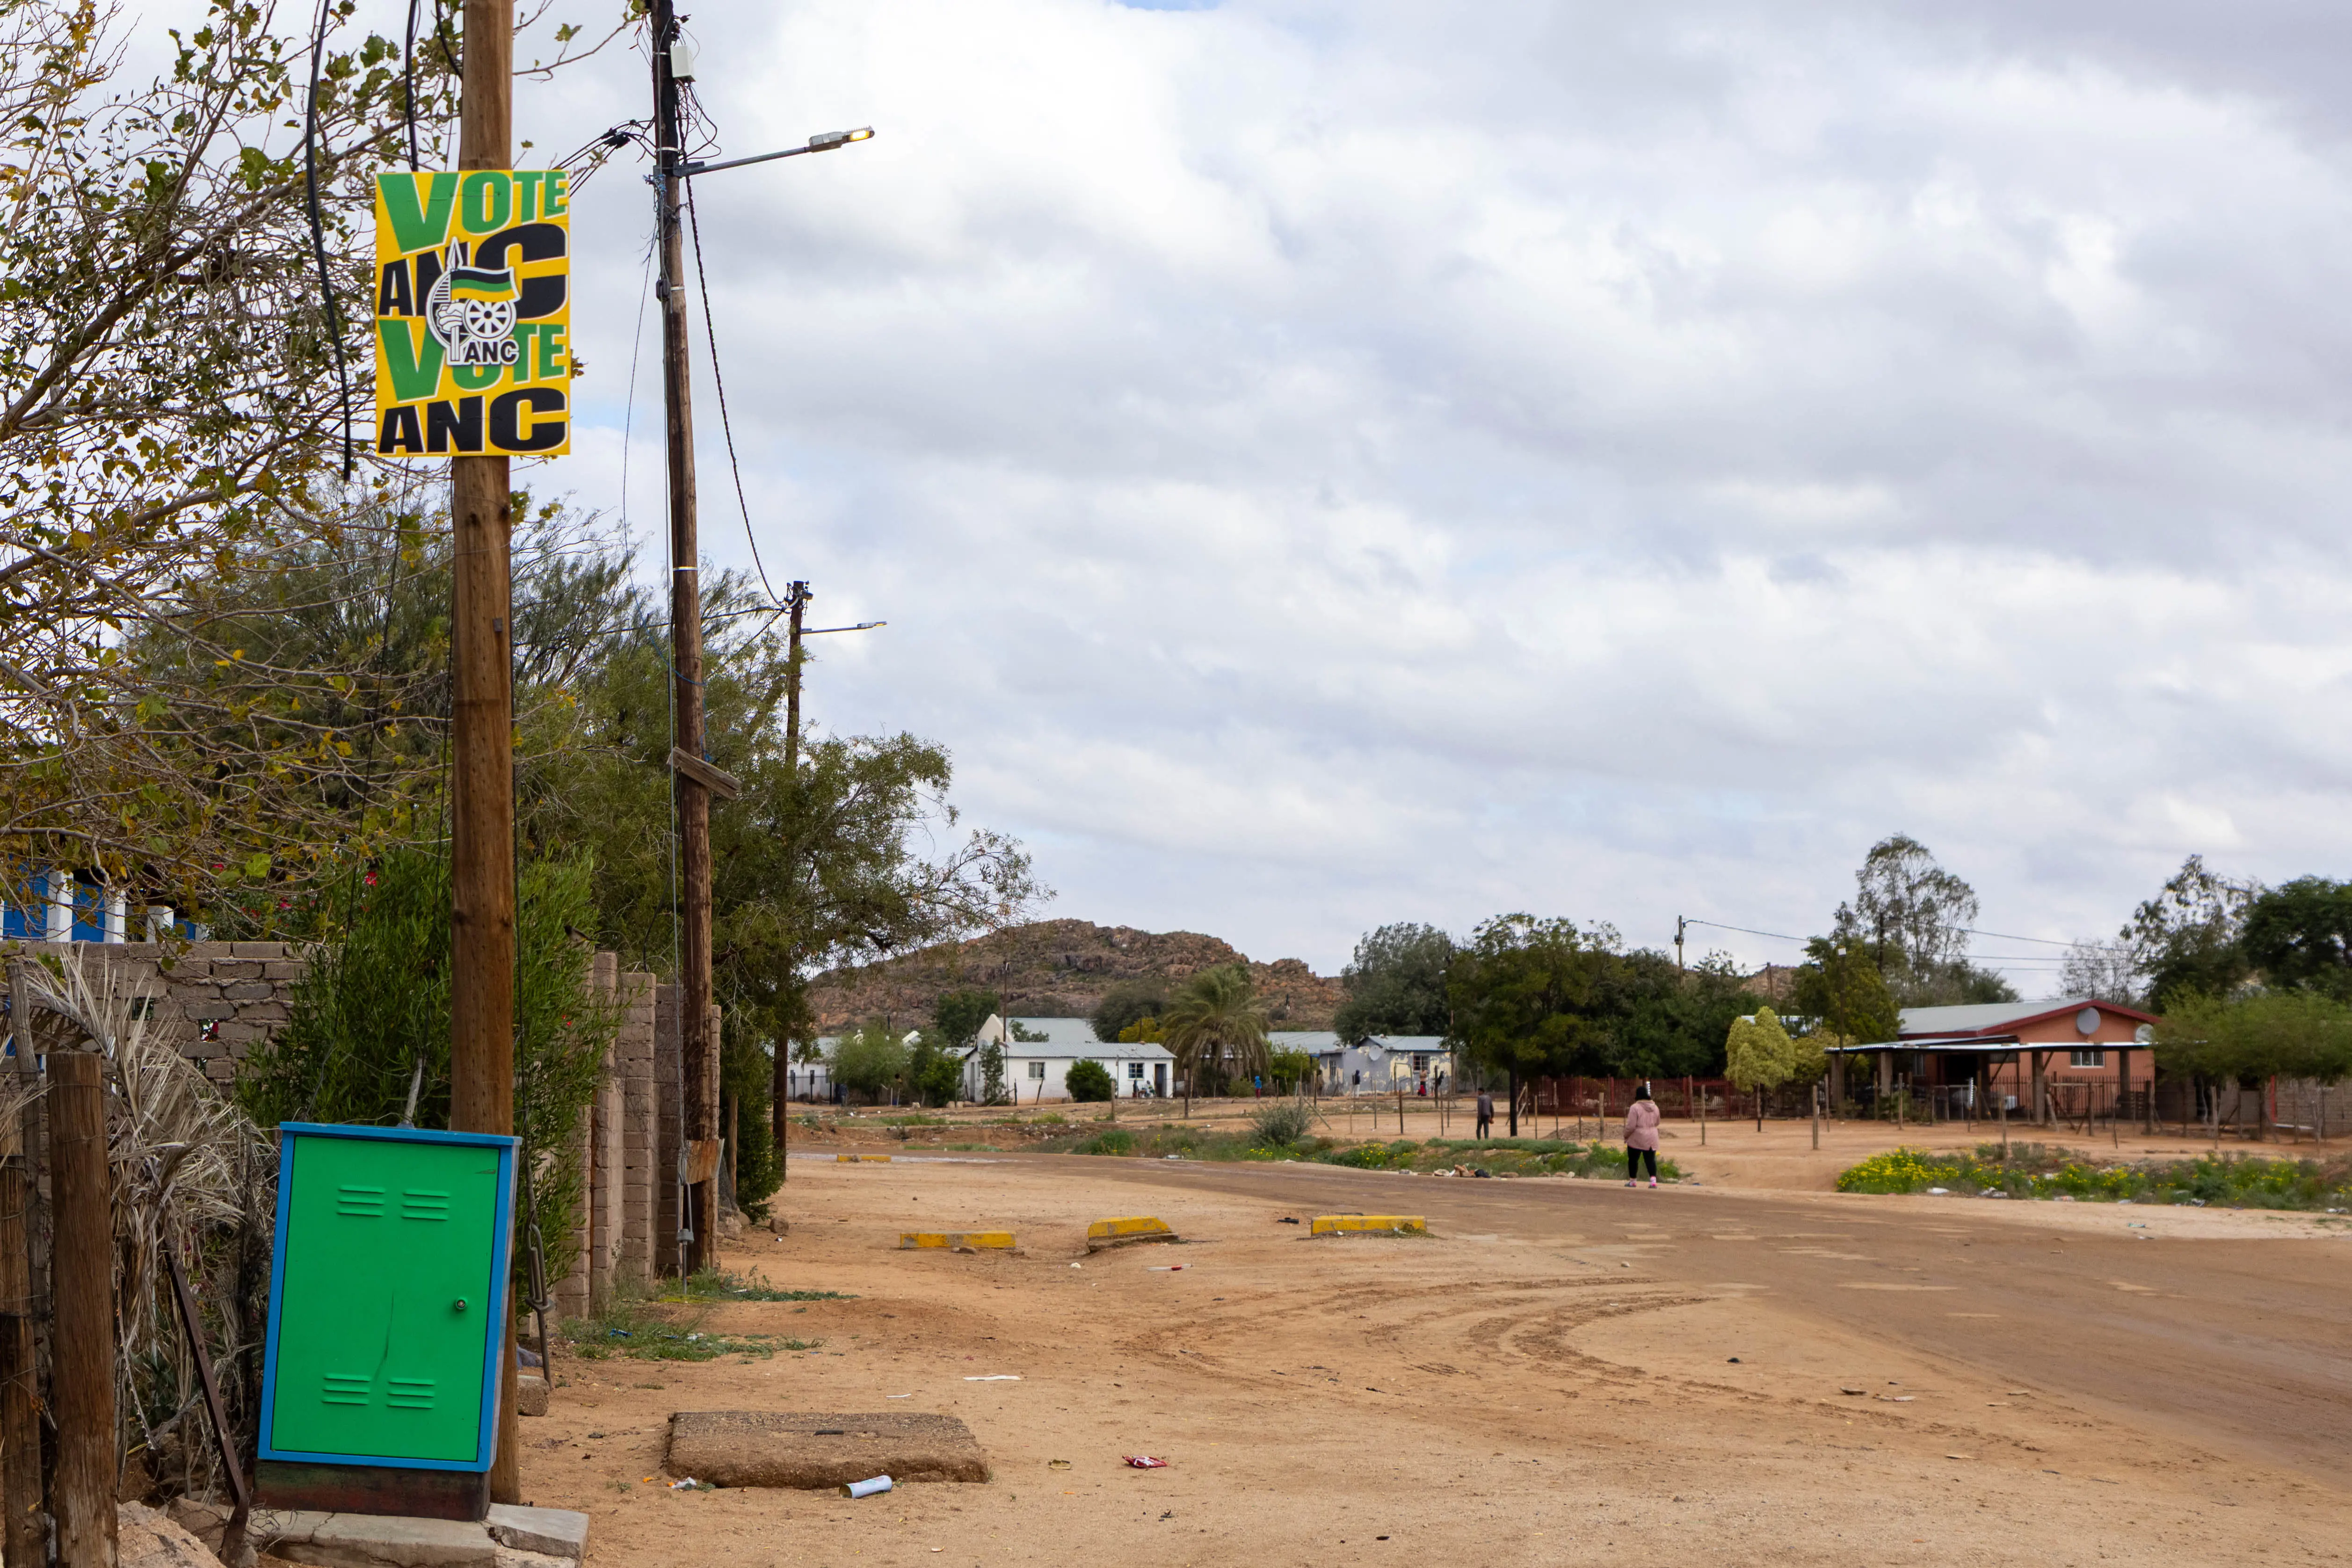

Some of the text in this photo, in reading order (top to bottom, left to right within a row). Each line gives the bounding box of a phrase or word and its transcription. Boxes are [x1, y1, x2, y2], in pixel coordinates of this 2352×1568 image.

[377, 172, 567, 254] VOTE
[464, 340, 518, 363] ANC
[378, 387, 567, 454] ANC
